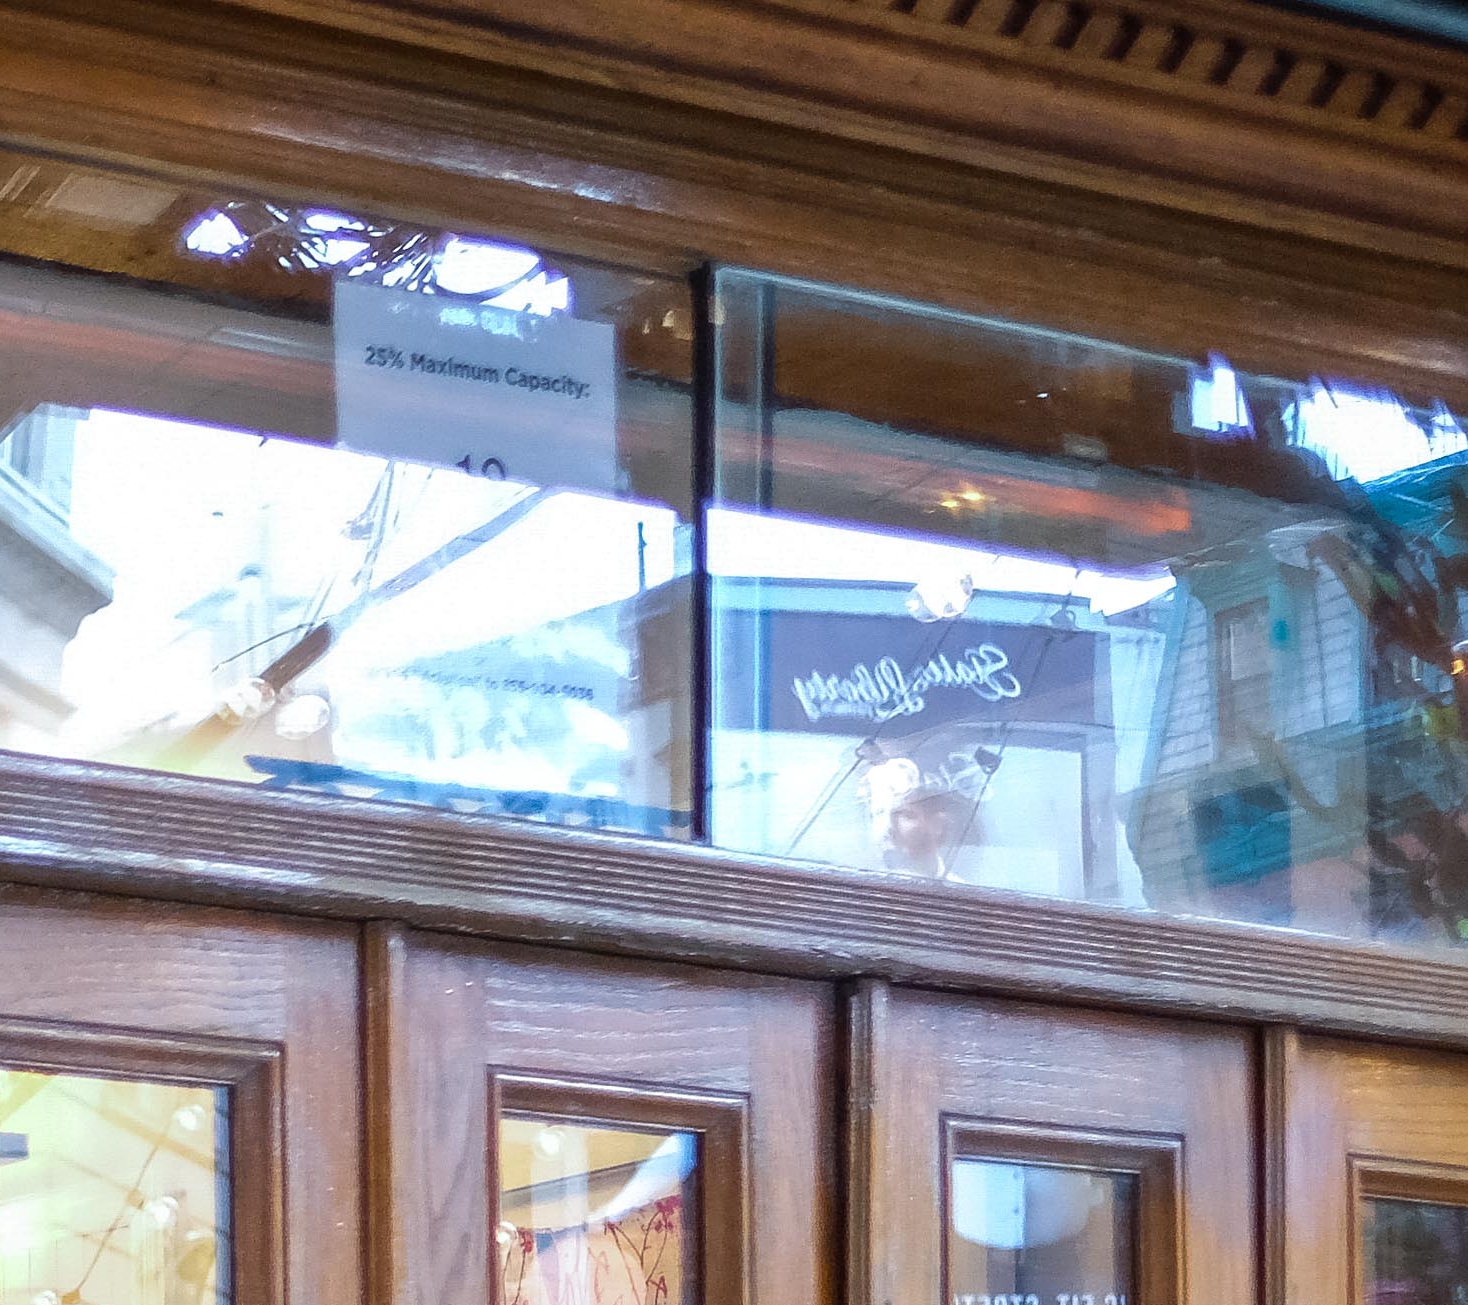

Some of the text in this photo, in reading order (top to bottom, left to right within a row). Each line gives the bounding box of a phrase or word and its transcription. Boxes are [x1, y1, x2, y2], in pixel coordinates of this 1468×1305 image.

[363, 345, 591, 400] 25% Maximum Capacity:
